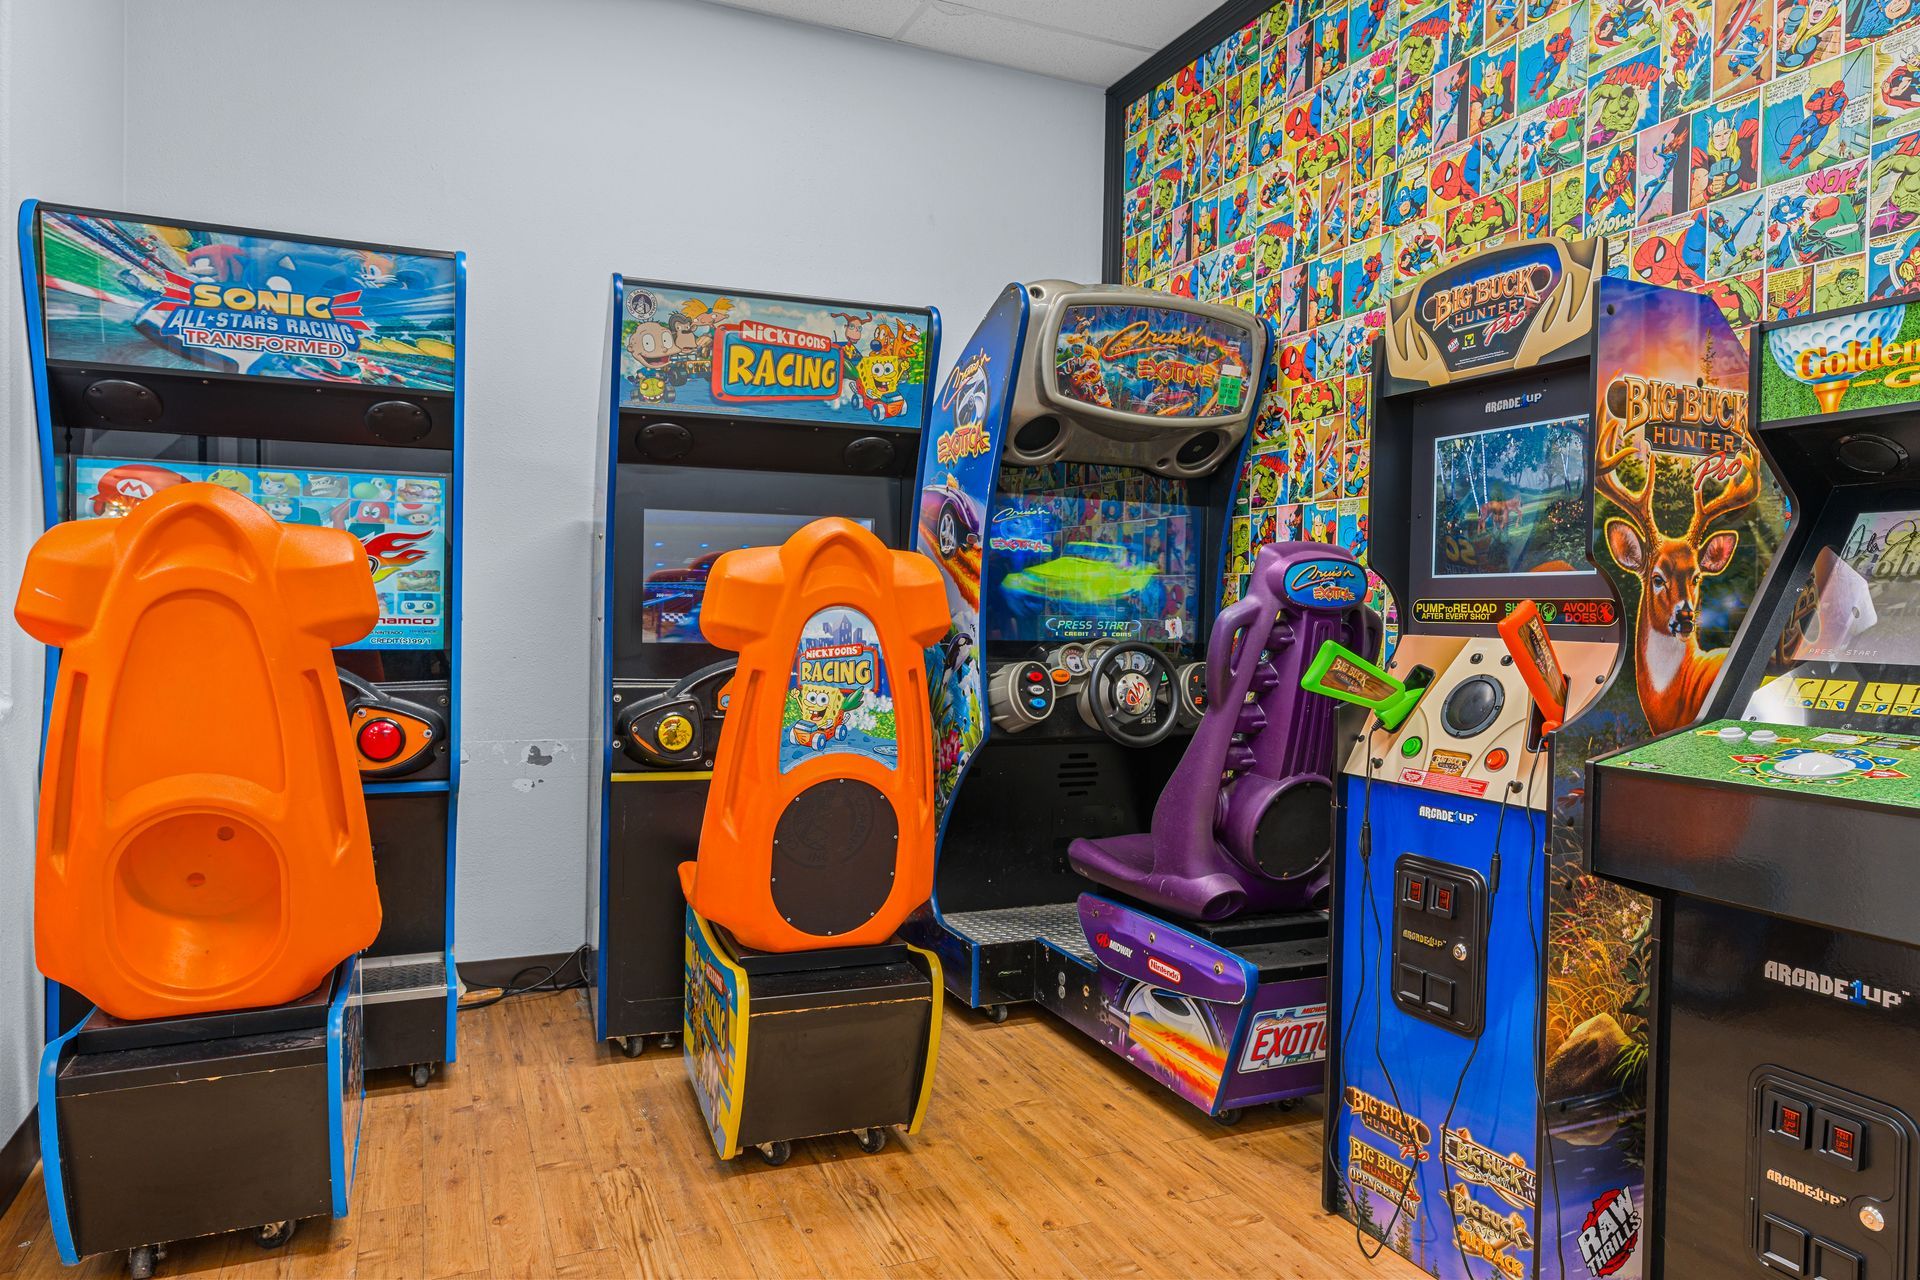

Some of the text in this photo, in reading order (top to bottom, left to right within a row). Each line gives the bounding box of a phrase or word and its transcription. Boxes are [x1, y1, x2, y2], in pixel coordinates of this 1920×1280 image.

[1603, 62, 1664, 91] ZWUMP!
[1805, 158, 1868, 195] WOK!
[194, 284, 332, 319] SONIC
[1433, 264, 1540, 331] BIG BUCK
[1455, 300, 1518, 326] HUNTER
[185, 329, 343, 357] TRANSFORMED
[286, 318, 356, 345] RACING
[1101, 320, 1215, 361] Cruis'n
[1482, 311, 1526, 347] Pro
[728, 345, 836, 389] RACING
[1137, 357, 1214, 387] EXOTICA
[1794, 336, 1920, 380] Golden
[1623, 376, 1750, 436] BIG BUCK
[1653, 427, 1735, 452] HUNTER
[1694, 450, 1742, 491] Pro
[992, 507, 1050, 523] Cruis'n
[1291, 565, 1354, 590] Cruis'n
[1416, 603, 1445, 613] PUMP
[1453, 603, 1497, 614] RELOAD
[1505, 602, 1541, 612] SHT
[1563, 602, 1597, 612] AVOID
[1565, 613, 1597, 622] DOES
[1057, 620, 1131, 631] PRESS START
[1846, 649, 1878, 657] START
[801, 660, 872, 685] RACING
[1332, 657, 1370, 688] BIG BUCK
[1109, 939, 1133, 958] MIDWAY
[1150, 960, 1180, 981] Nintendo
[1351, 1087, 1421, 1145] BIG BUCK
[1365, 1115, 1408, 1143] HUNTER
[1400, 1143, 1430, 1161] Pro
[1456, 1140, 1524, 1192] BIG BUCK
[1350, 1139, 1417, 1196] BIG BUCK
[1362, 1161, 1404, 1189] HUNTER
[1349, 1166, 1418, 1220] OPEN SEASON
[1454, 1192, 1525, 1248] BIG BUCK
[1577, 1185, 1635, 1262] RAW
[1458, 1224, 1524, 1280] OUTBACK
[1586, 1210, 1644, 1277] THRILLS
